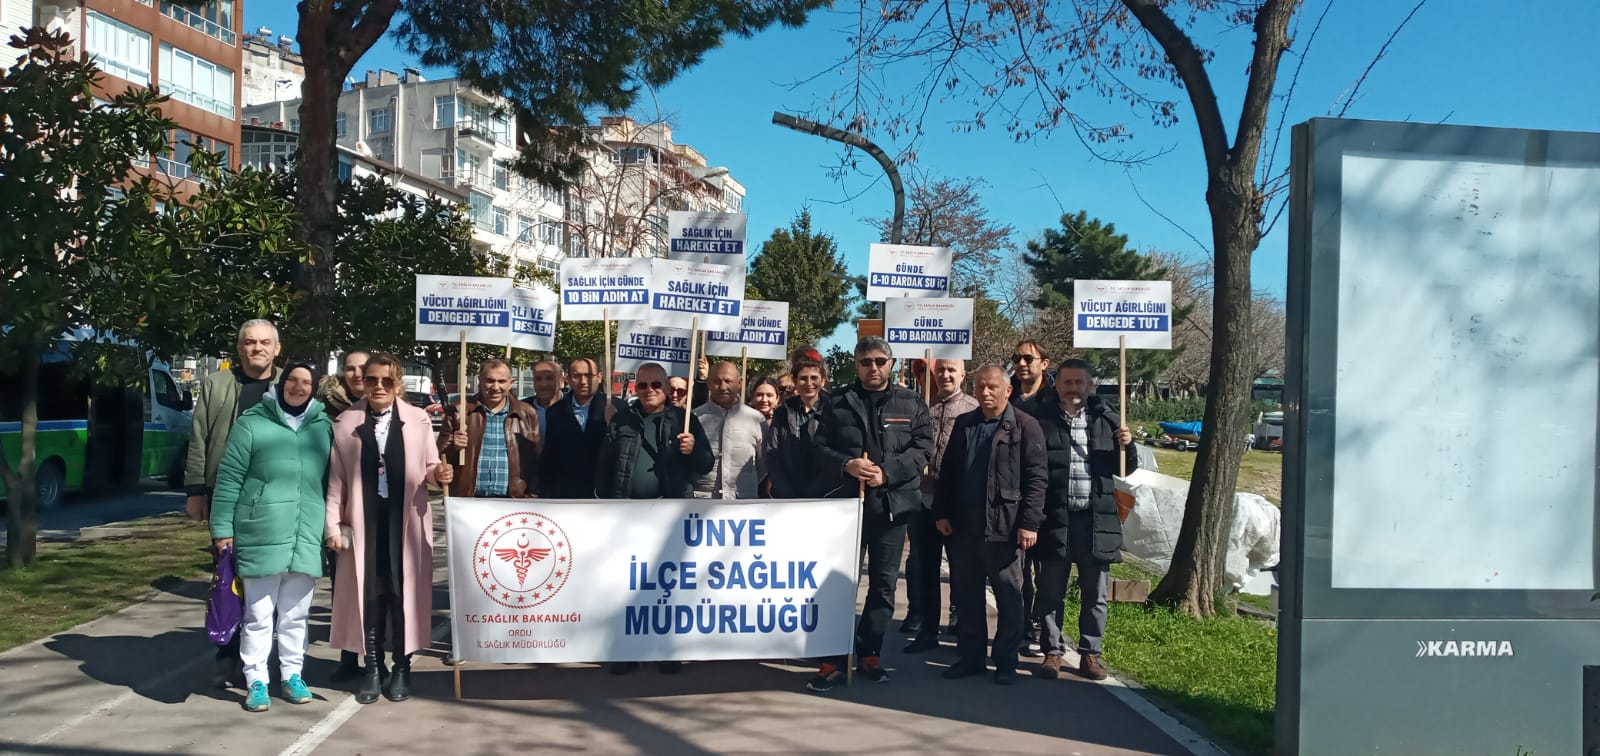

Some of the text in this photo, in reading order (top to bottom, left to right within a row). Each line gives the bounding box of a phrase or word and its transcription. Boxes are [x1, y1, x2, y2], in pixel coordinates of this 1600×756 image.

[682, 226, 733, 240] SAĞLIK İÇİN
[676, 241, 738, 252] HAREKET ET
[895, 262, 924, 273] GÜNDE
[568, 275, 644, 288] SAĞLIK İÇİN GÜNDE
[872, 274, 889, 284] 8-10
[891, 275, 923, 287] BARDAK
[925, 276, 936, 287] SU
[668, 279, 729, 298] SAĞLIK İÇİN
[422, 294, 454, 308] VÜCUT
[457, 296, 507, 309] AĞIRLIĞINI
[568, 291, 579, 303] 10
[603, 291, 629, 302] ADIM
[631, 291, 644, 302] AT
[659, 295, 716, 312] HAREKET
[718, 301, 734, 314] ET
[1080, 299, 1166, 313] VÜCUT AĞIRLIĞINI
[428, 311, 500, 324] DENGEDE TUT
[530, 307, 544, 320] VE
[514, 321, 552, 335] BESLEN
[758, 316, 782, 328] GÜNDE
[914, 316, 943, 327] GÜNDE
[1086, 316, 1160, 329] DENGEDE TUT
[673, 337, 688, 348] VE
[742, 331, 766, 342] ADIM
[768, 333, 782, 343] AT
[889, 331, 907, 340] 8-10
[910, 331, 943, 341] BARDAK
[945, 331, 956, 341] SU
[660, 350, 691, 361] BESLE
[684, 513, 766, 547] ÜNYE
[629, 554, 818, 598] İLÇE SAĞLIK
[465, 612, 581, 623] T.C. SAĞLIK BAKANLIĞI
[625, 597, 819, 635] MÜDÜRLÜĞÜ
[508, 629, 532, 637] ORDU
[485, 639, 511, 649] SAĞLIK
[512, 638, 566, 648] MÜDÜRLÜĞÜ
[1427, 640, 1514, 656] KARMA
